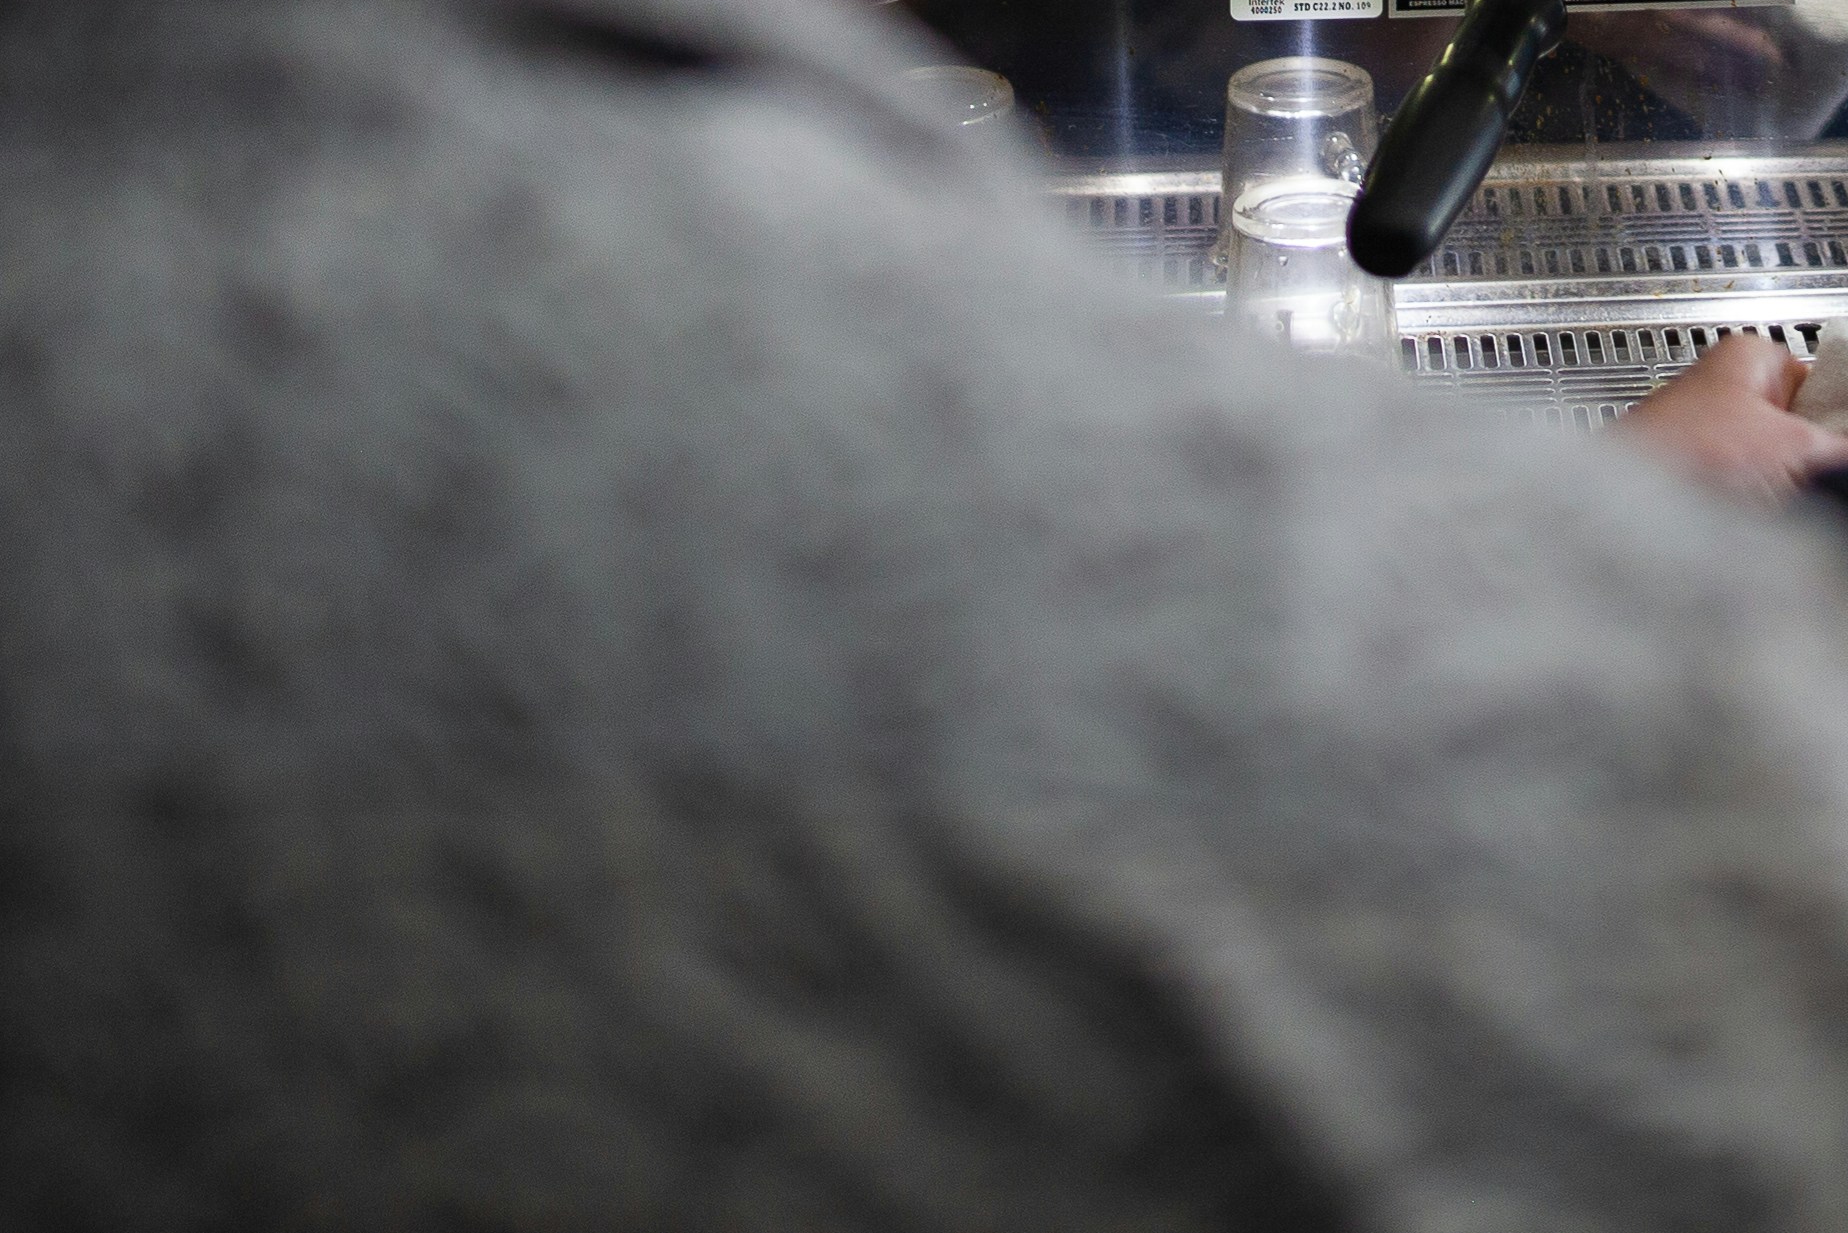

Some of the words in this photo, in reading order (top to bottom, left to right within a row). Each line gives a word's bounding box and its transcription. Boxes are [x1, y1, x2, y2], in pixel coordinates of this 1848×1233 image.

[1294, 2, 1311, 12] STD
[1312, 2, 1337, 12] C22.2
[1338, 2, 1354, 12] NO.
[1408, 0, 1447, 7] ESPRESSO
